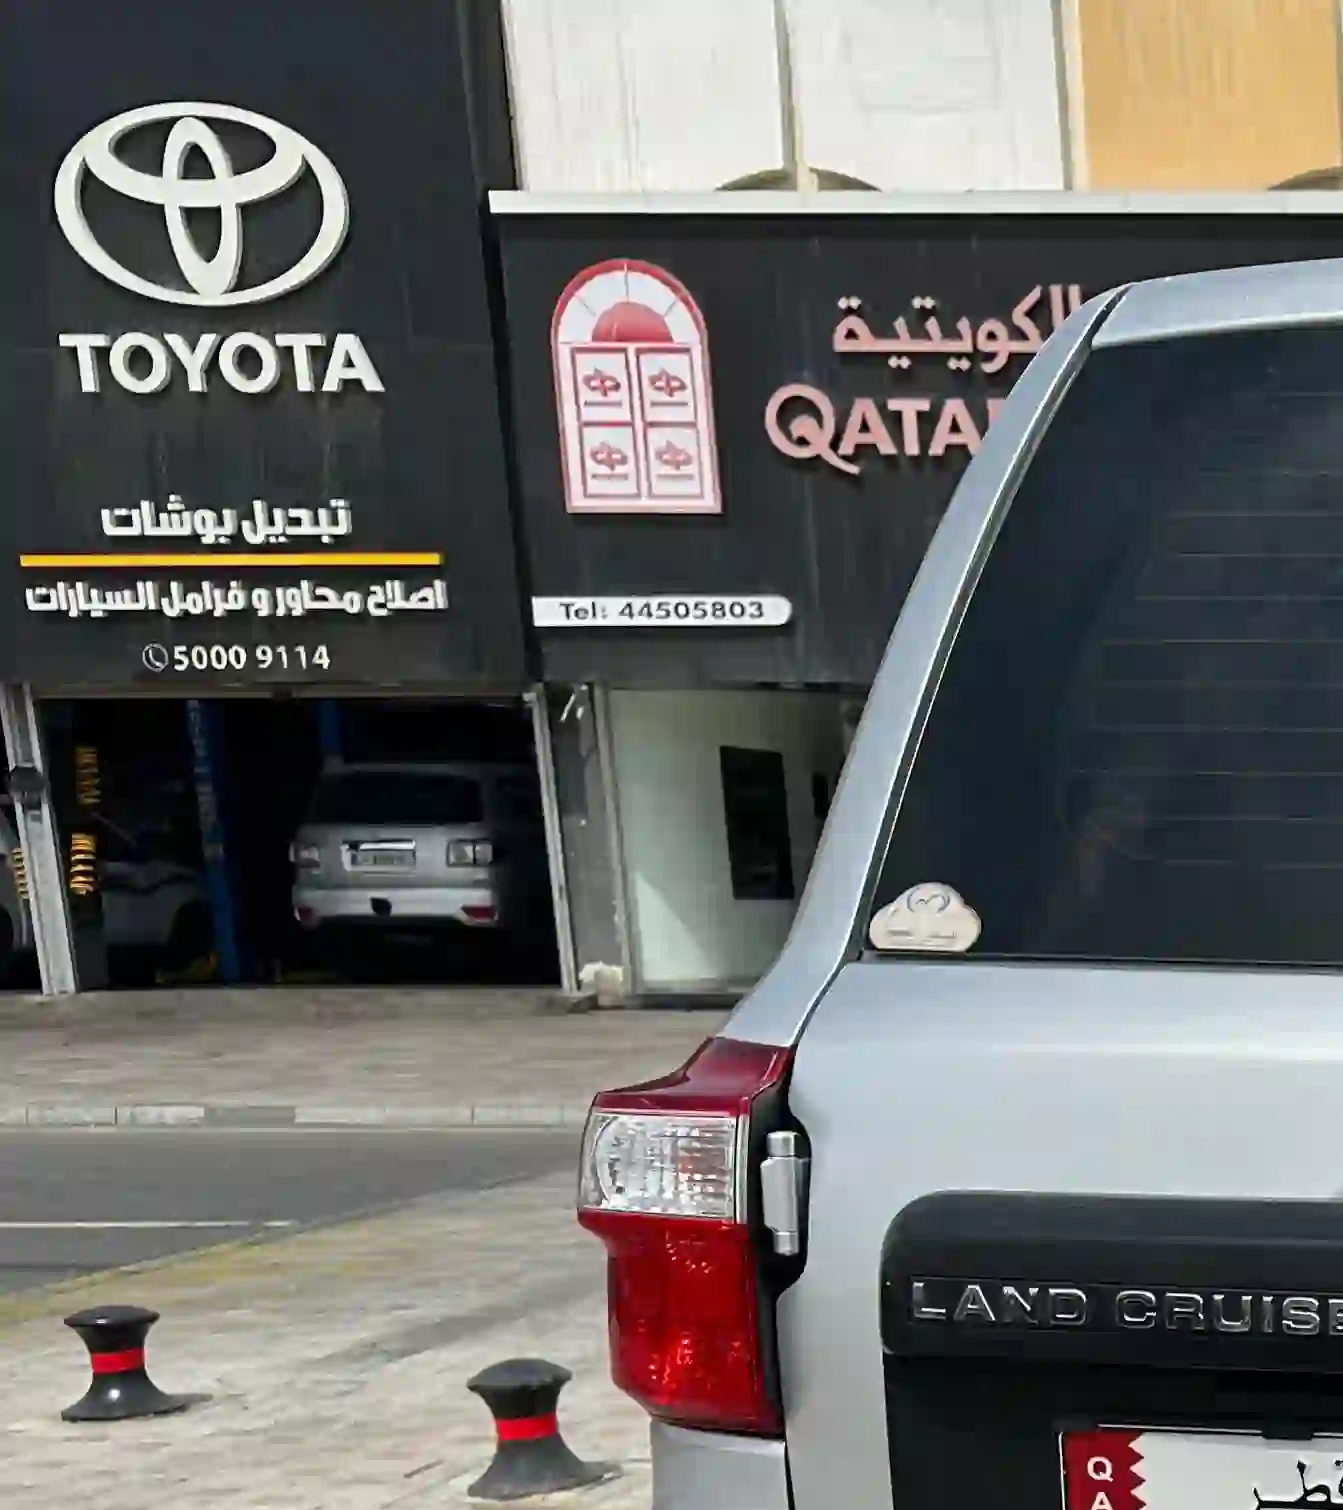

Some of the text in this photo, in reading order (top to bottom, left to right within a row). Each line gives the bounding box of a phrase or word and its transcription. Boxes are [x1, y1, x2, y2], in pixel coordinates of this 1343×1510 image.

[58, 332, 386, 393] TOYOTA
[765, 383, 1006, 475] QATA
[100, 494, 353, 544] تبديل بوشات
[25, 580, 157, 617] السيارات
[161, 580, 246, 617] فرامل
[619, 600, 765, 620] 44505803
[173, 645, 331, 671] 5000 9114
[911, 1281, 1090, 1327] LAND
